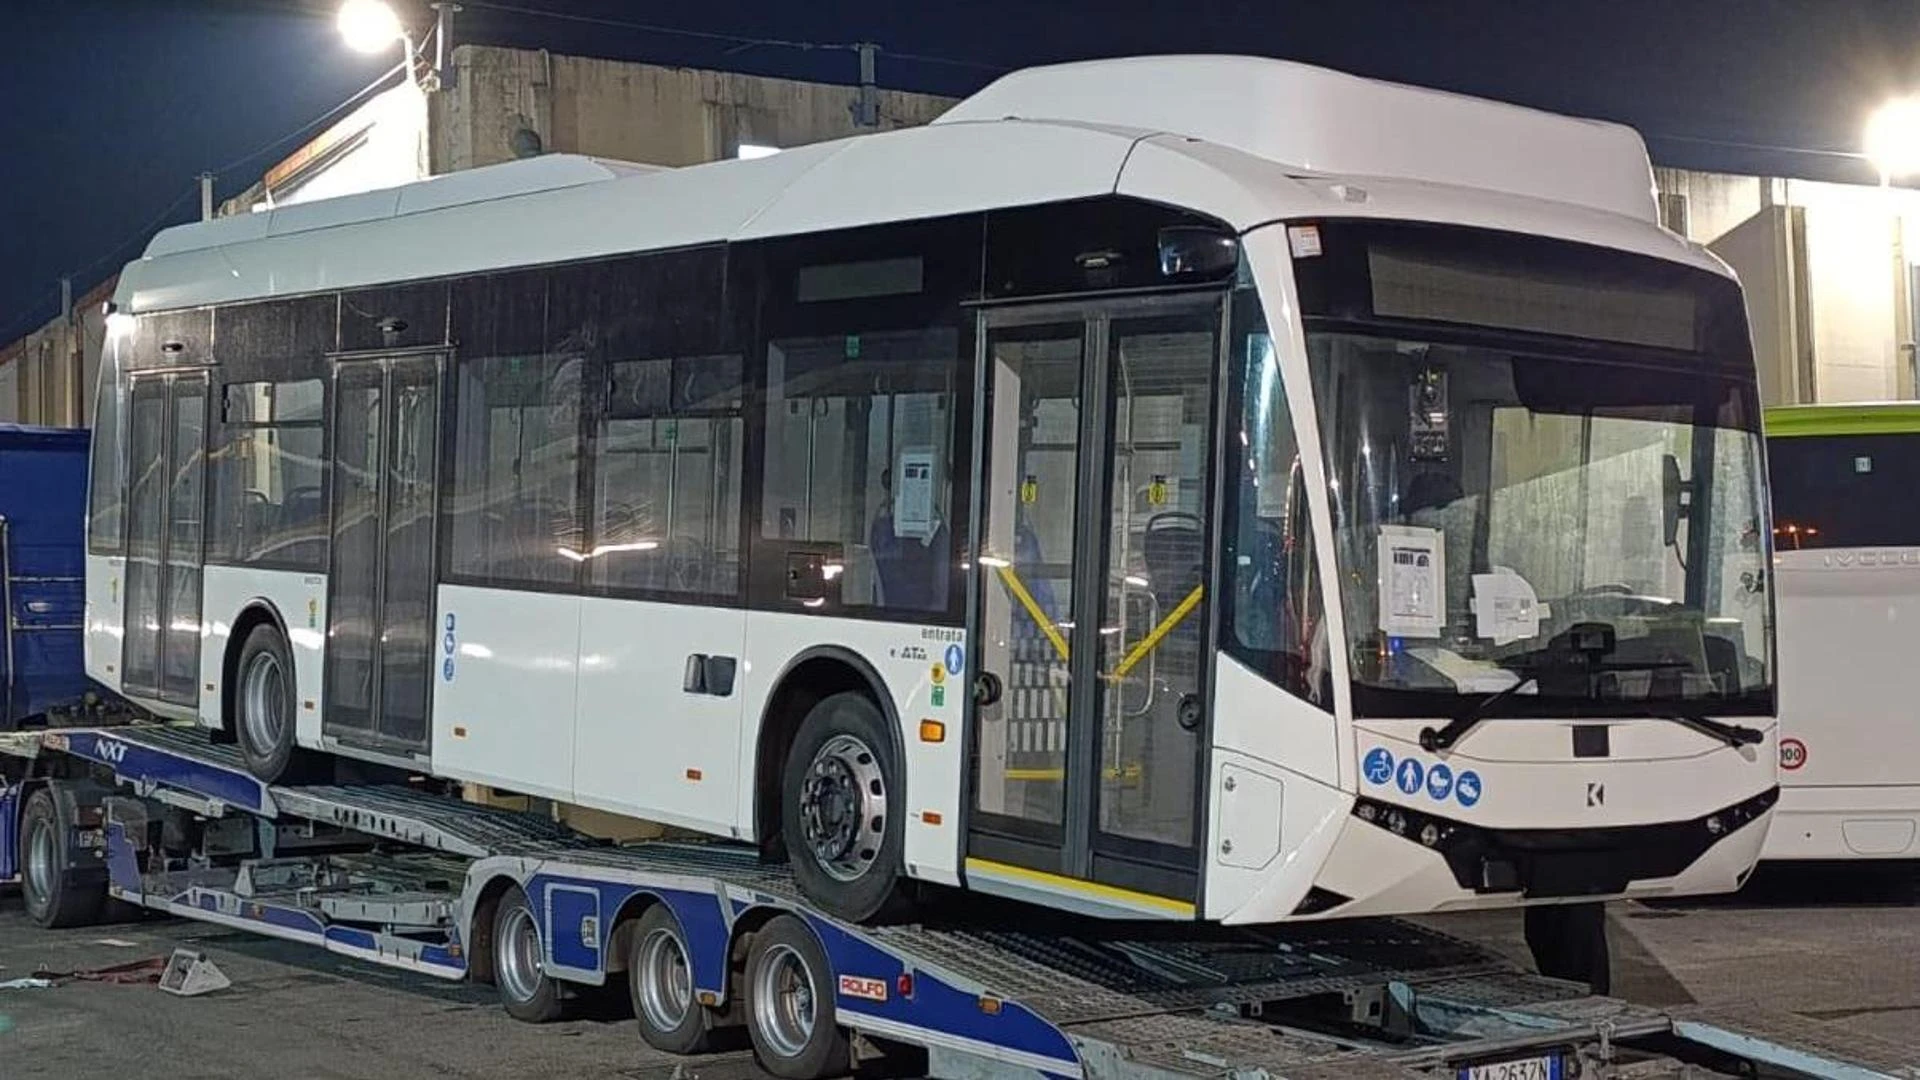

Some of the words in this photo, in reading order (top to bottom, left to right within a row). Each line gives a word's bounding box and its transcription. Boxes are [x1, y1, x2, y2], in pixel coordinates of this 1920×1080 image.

[921, 628, 963, 642] entrata
[94, 739, 128, 762] NXT
[842, 978, 885, 997] ROLFO
